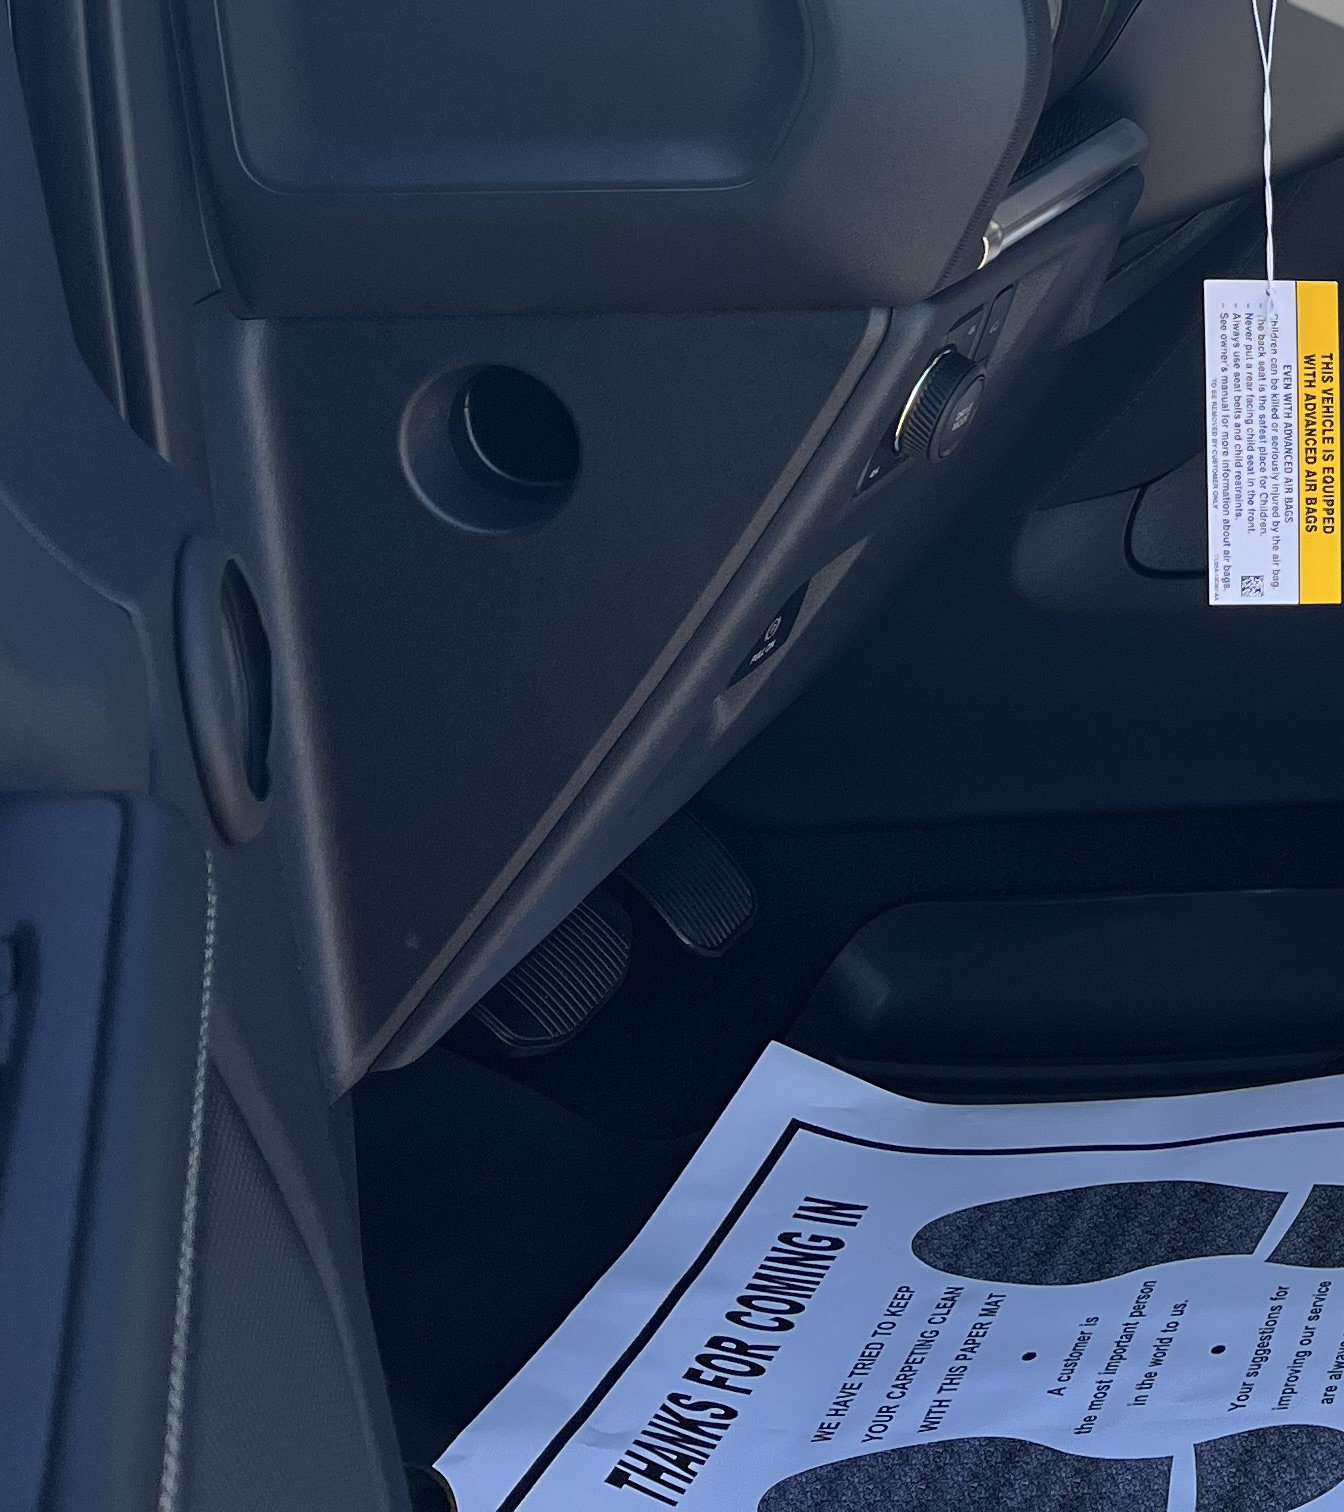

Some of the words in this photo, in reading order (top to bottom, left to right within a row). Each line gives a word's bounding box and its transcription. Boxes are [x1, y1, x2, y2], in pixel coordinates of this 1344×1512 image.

[1220, 313, 1228, 330] See
[1231, 313, 1241, 348] Always
[1245, 313, 1253, 341] Never
[1221, 334, 1229, 372] owner's
[1243, 345, 1253, 360] put
[1258, 334, 1266, 357] back
[1258, 361, 1266, 381] seat
[1283, 365, 1292, 389] EVEN
[1304, 354, 1316, 388] WITH
[1321, 353, 1333, 383] THIS
[1221, 376, 1230, 412] manual
[1233, 372, 1241, 392] seat
[1259, 384, 1266, 392] is
[1271, 379, 1279, 390] be
[1234, 395, 1242, 419] belts
[1244, 395, 1255, 424] facing
[1259, 395, 1267, 410] the
[1271, 394, 1279, 419] killed
[1284, 393, 1292, 418] WITH
[1222, 415, 1230, 428] for
[1259, 414, 1267, 443] safest
[1272, 423, 1279, 432] or
[1304, 393, 1317, 464] ADVANCED
[1322, 388, 1334, 444] VEHICLE
[1222, 432, 1230, 456] more
[1247, 428, 1255, 451] child
[1284, 422, 1293, 473] ADVANCED
[1235, 444, 1243, 467] child
[1247, 455, 1255, 475] seat
[1259, 447, 1268, 472] place
[1270, 436, 1280, 480] seriously
[1323, 450, 1334, 461] IS
[1223, 460, 1231, 515] information
[1259, 476, 1268, 489] for
[1284, 477, 1293, 493] AIR
[1305, 470, 1316, 492] AIR
[1248, 490, 1256, 505] the
[1271, 484, 1281, 517] injured
[1285, 497, 1293, 523] BAGS
[1323, 467, 1334, 534] EQUIPPED
[1271, 521, 1281, 532] by
[1306, 497, 1317, 532] BAGS
[1223, 519, 1231, 547] about
[1272, 535, 1281, 551] the
[1223, 550, 1231, 561] air
[1272, 554, 1281, 566] air
[792, 1196, 869, 1227] IN
[725, 1232, 845, 1332] COMING
[884, 1285, 915, 1321] KEEP
[978, 1292, 1007, 1319] MAT
[1173, 1300, 1189, 1317] us.
[1307, 1280, 1332, 1323] service
[873, 1317, 897, 1339] TO
[1164, 1318, 1179, 1334] to
[1300, 1322, 1317, 1350] our
[954, 1321, 988, 1363] PAPER
[1152, 1333, 1173, 1367] world
[1228, 1381, 1252, 1413] Your
[1248, 1312, 1280, 1379] suggestions
[1269, 1285, 1291, 1311] for
[682, 1335, 781, 1395] FOR
[848, 1340, 884, 1380] TRIED
[862, 1401, 899, 1444] YOUR
[887, 1326, 940, 1400] CARPETING
[927, 1286, 965, 1326] CLEAN
[1047, 1386, 1065, 1396] A
[1058, 1329, 1093, 1383] customer
[1079, 1316, 1099, 1327] is
[1073, 1415, 1095, 1436] the
[1088, 1379, 1112, 1415] most
[1102, 1321, 1139, 1379] important
[1129, 1280, 1157, 1321] person
[947, 1362, 969, 1396] THIS
[1135, 1367, 1158, 1391] the
[1271, 1350, 1313, 1411] improving
[825, 1382, 862, 1418] HAVE
[1128, 1392, 1147, 1408] in
[1321, 1385, 1337, 1406] are
[917, 1398, 952, 1434] WITH
[811, 1422, 841, 1444] WE
[604, 1392, 738, 1507] THANKS
